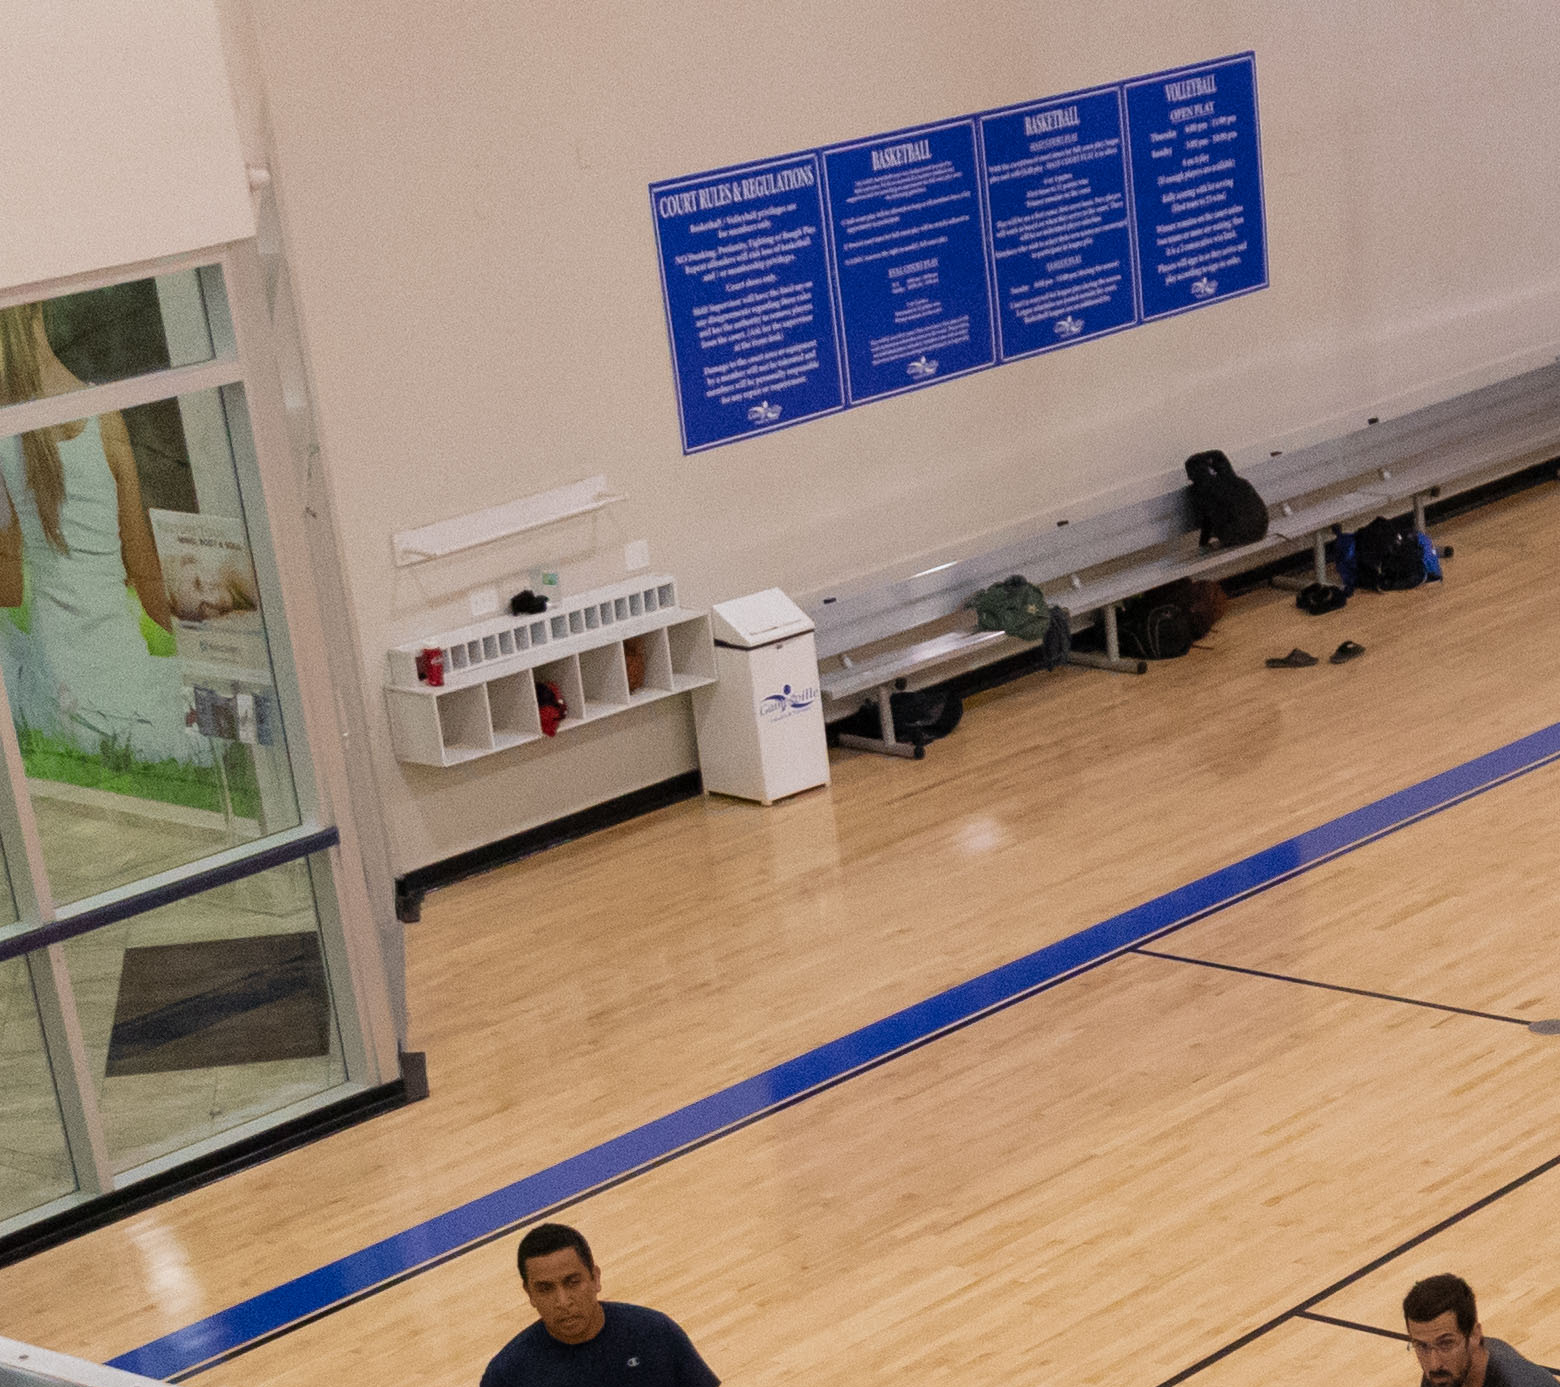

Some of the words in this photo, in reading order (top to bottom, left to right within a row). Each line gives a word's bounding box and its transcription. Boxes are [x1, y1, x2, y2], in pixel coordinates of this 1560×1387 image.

[1165, 74, 1217, 102] VOLLEYBALL
[1025, 105, 1080, 136] BASKETBALL
[1170, 104, 1194, 123] OPEN
[1195, 101, 1216, 117] PLAY
[872, 139, 932, 171] BASKETBALL
[660, 191, 697, 218] COURT
[699, 182, 731, 210] RULES
[733, 181, 741, 203] &
[743, 165, 814, 200] REGULATIONS
